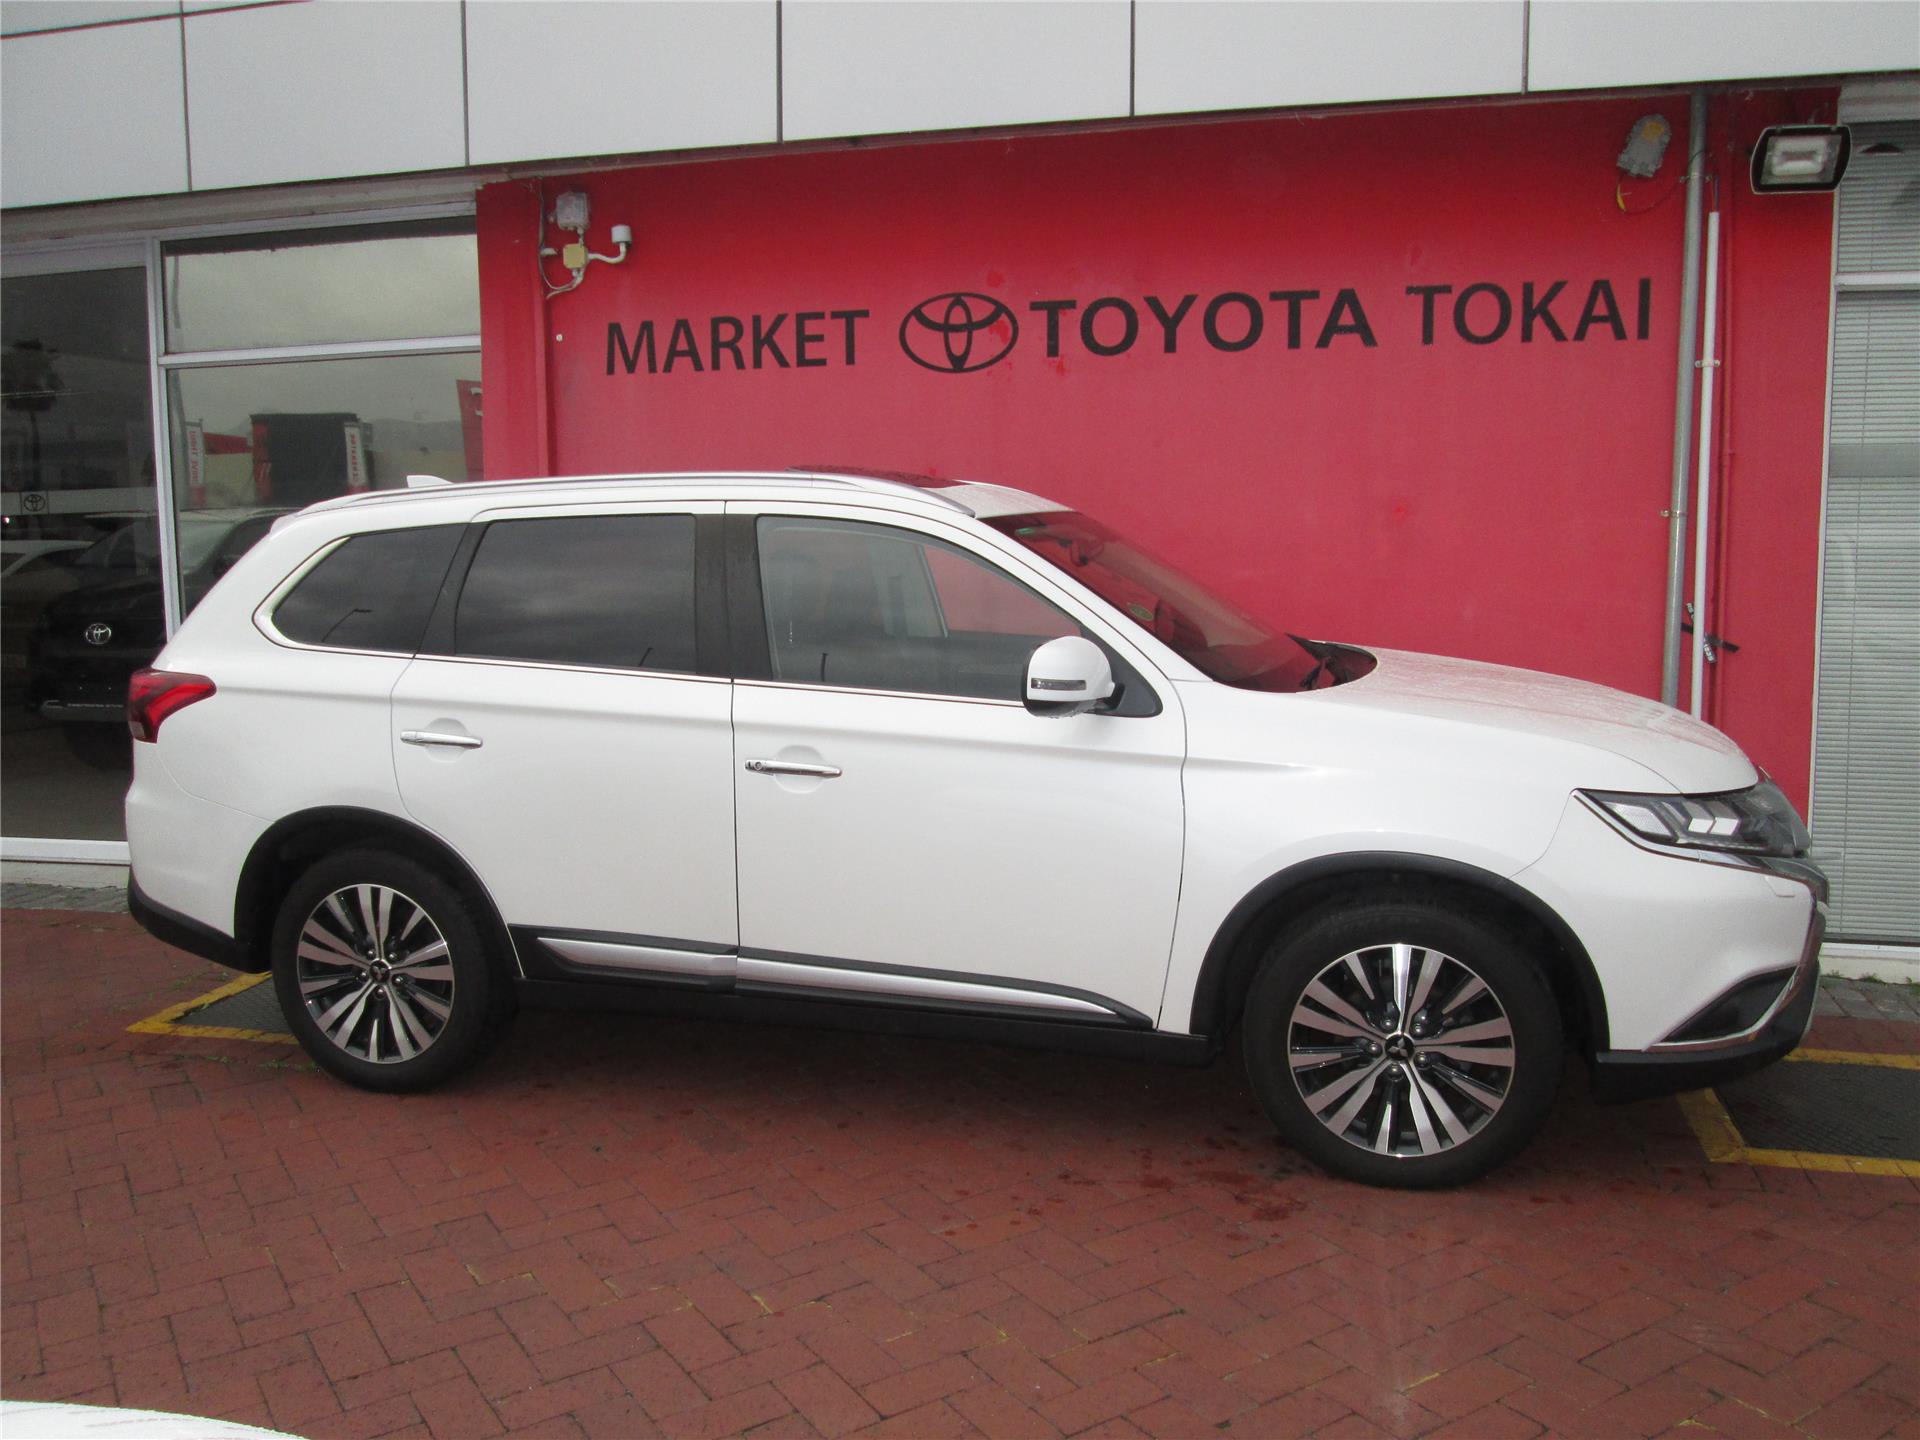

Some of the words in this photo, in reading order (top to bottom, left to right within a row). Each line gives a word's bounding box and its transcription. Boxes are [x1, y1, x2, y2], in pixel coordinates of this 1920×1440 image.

[605, 309, 870, 376] MARKET
[1029, 287, 1378, 358] TOYOTA
[1405, 277, 1653, 346] TOKAI
